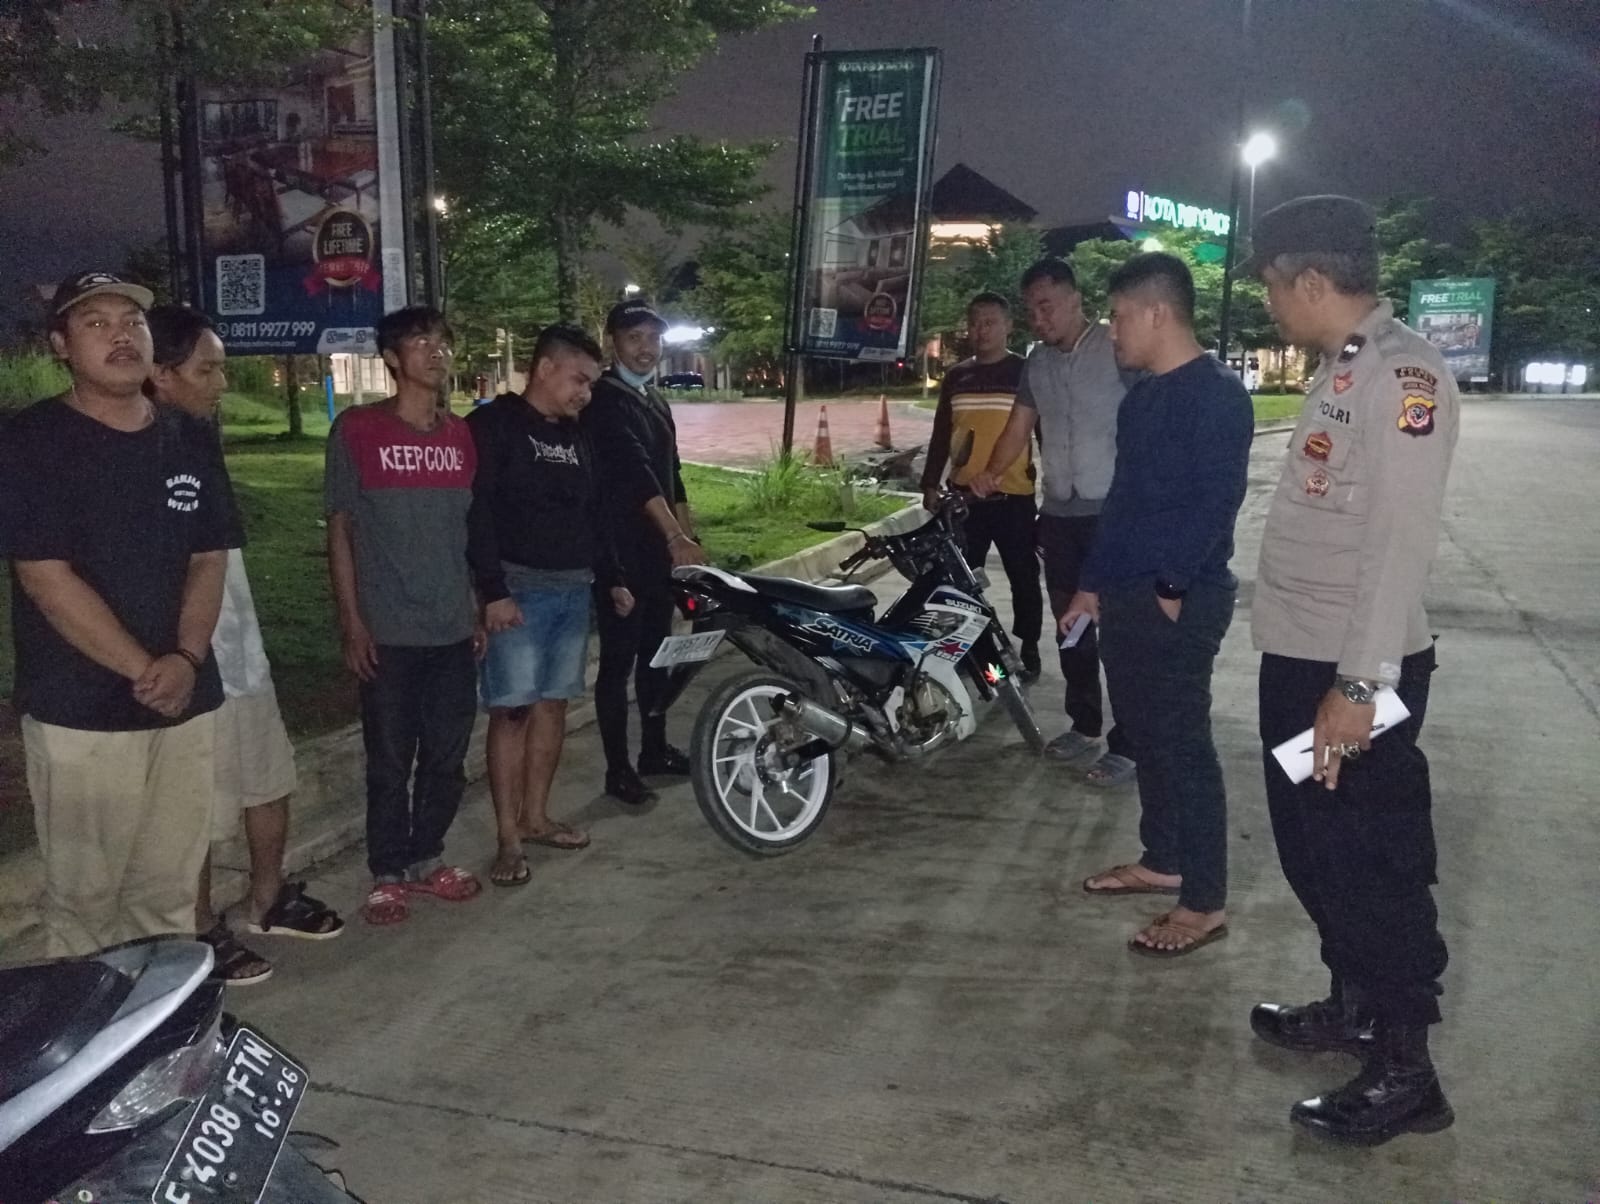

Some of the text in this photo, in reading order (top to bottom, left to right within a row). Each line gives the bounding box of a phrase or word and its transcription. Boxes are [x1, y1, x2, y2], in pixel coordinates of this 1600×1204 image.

[841, 92, 903, 122] FREE
[839, 123, 904, 147] TRIAL
[332, 223, 353, 237] FREE
[1420, 291, 1482, 304] FREE TRIAL
[230, 322, 257, 338] 0811
[259, 322, 290, 337] 9977
[291, 321, 316, 337] 999
[379, 446, 463, 472] KEEP COOL
[945, 598, 982, 614] SUZUKI
[807, 617, 879, 652] SATRIA
[185, 1104, 241, 1183] 4038
